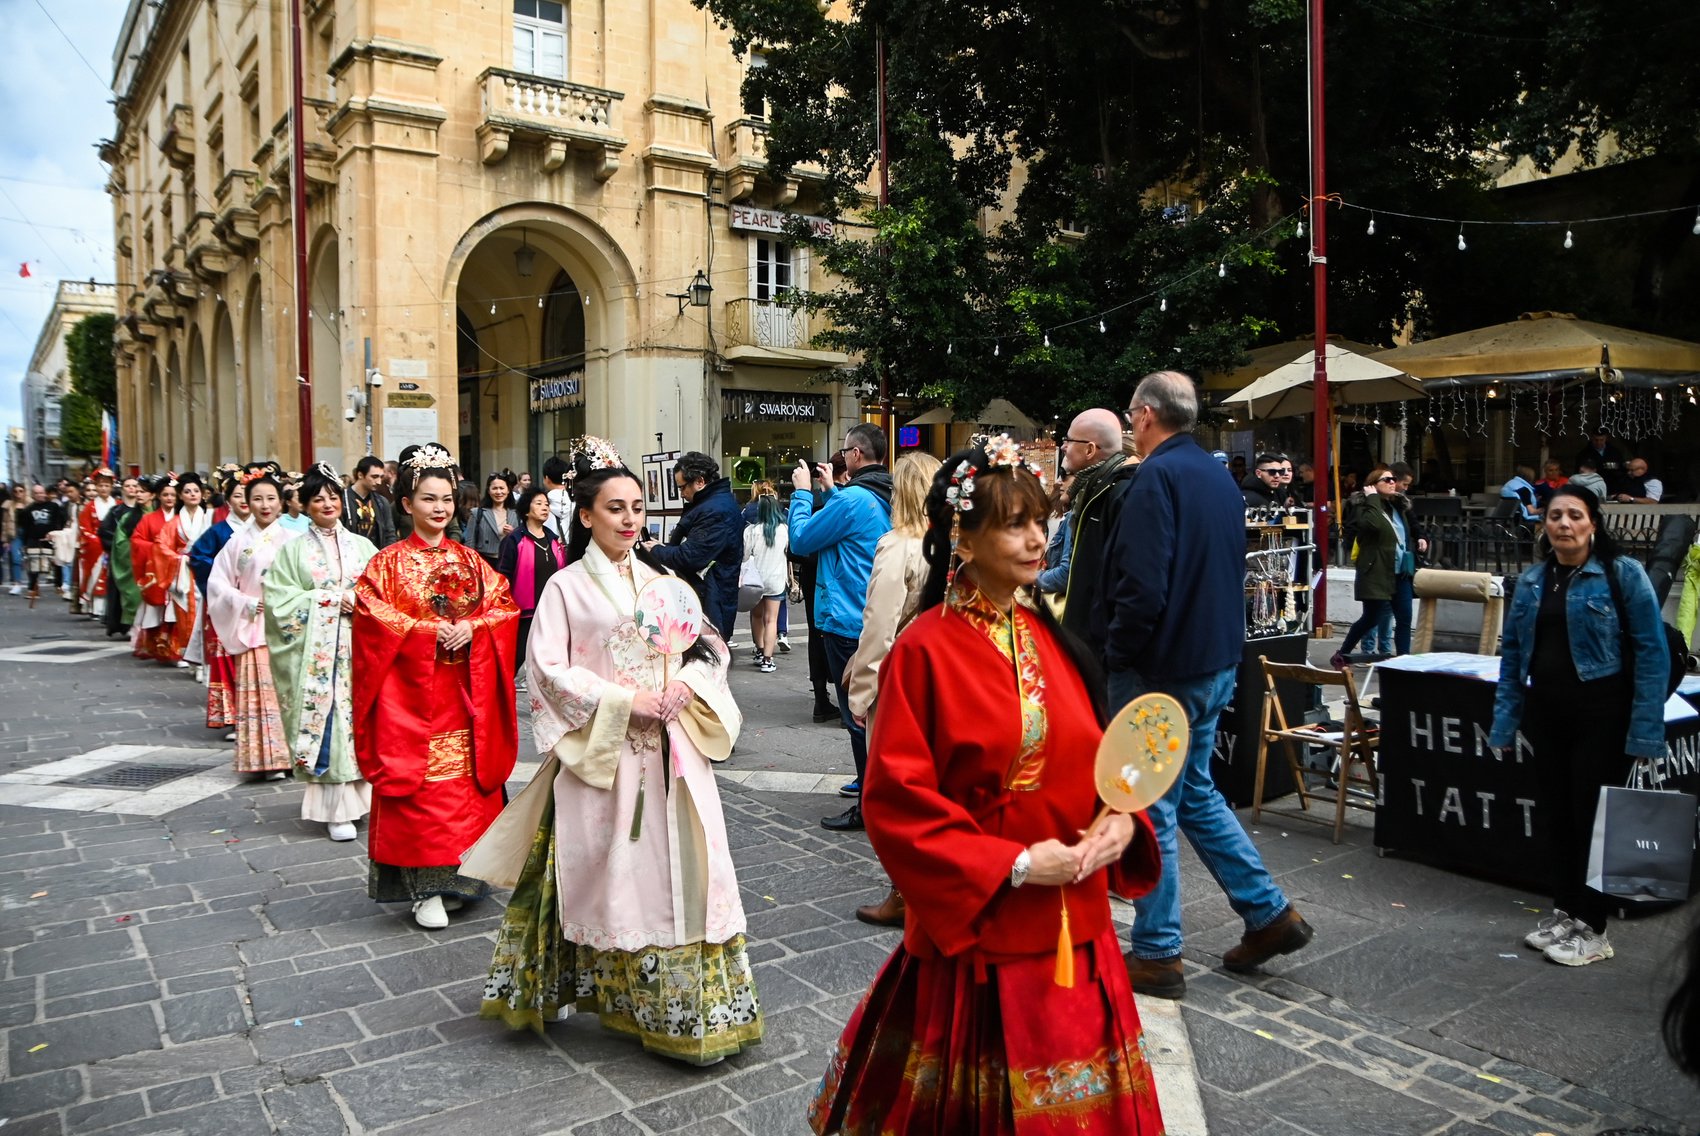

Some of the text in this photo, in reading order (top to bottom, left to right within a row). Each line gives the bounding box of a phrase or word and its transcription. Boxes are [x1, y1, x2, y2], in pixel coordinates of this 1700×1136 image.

[540, 378, 578, 400] SWAROVSKI
[759, 403, 815, 416] SWAROVSKI
[1409, 711, 1535, 763] HENN
[1637, 731, 1700, 790] HENN
[1410, 778, 1536, 837] TATT
